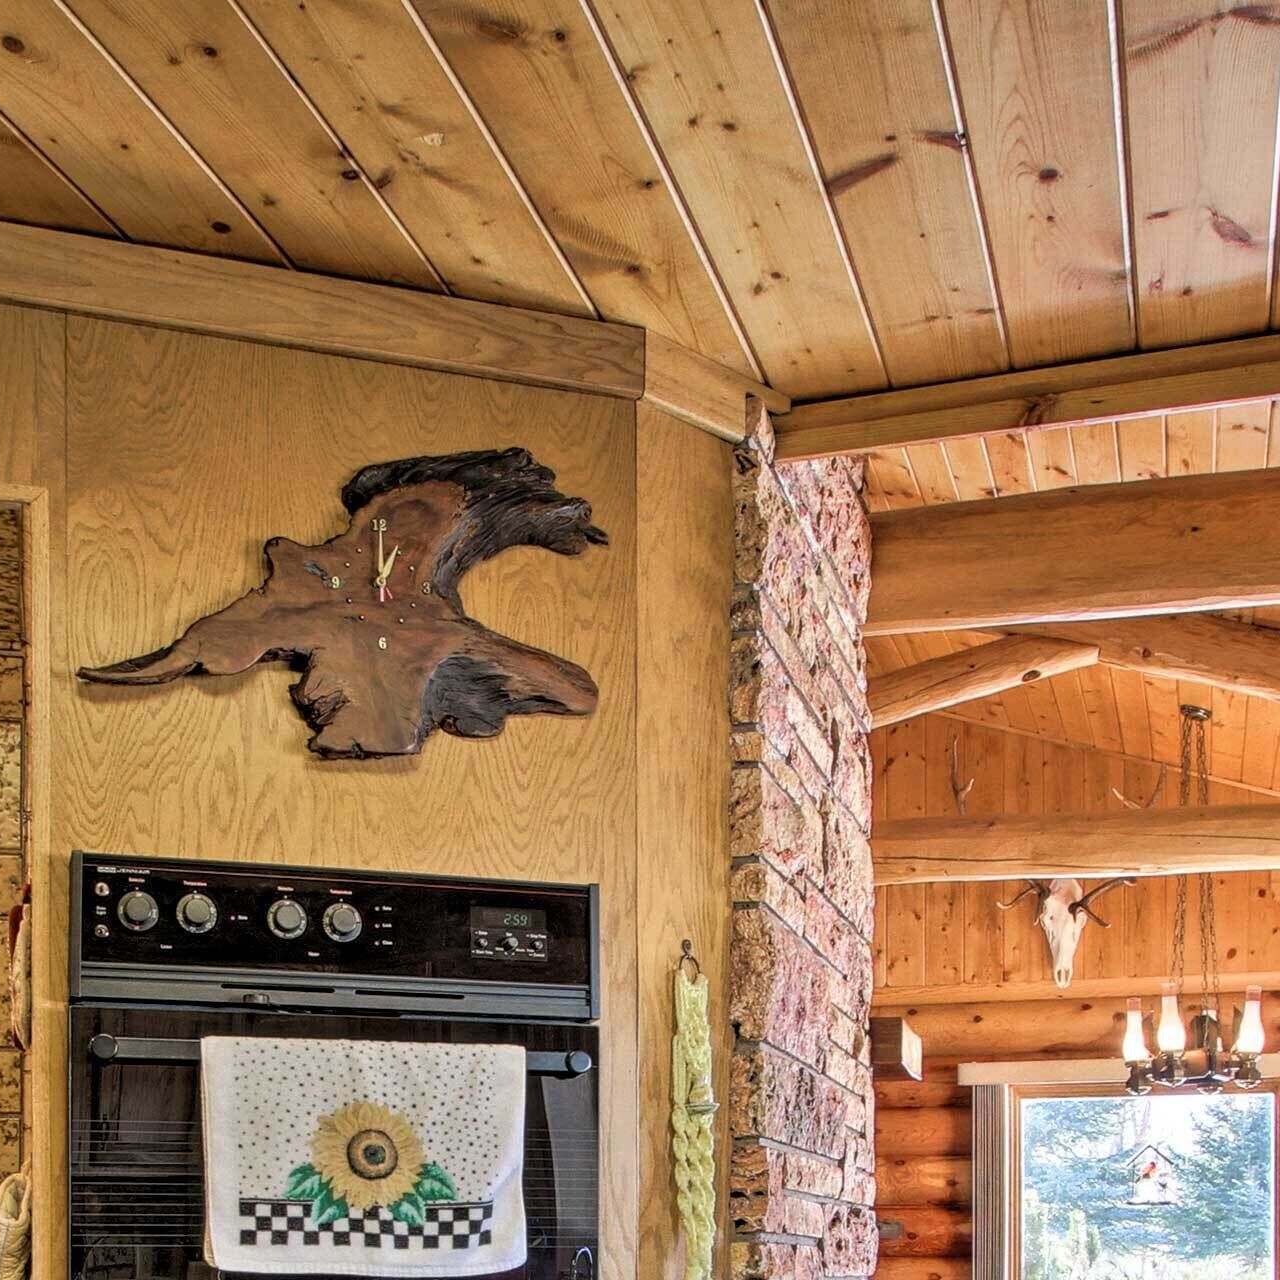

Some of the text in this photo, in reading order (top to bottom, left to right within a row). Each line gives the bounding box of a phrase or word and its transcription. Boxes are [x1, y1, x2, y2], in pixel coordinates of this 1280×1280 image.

[372, 519, 387, 531] 12
[332, 576, 340, 589] 9
[423, 582, 432, 594] 3
[378, 637, 387, 650] 6
